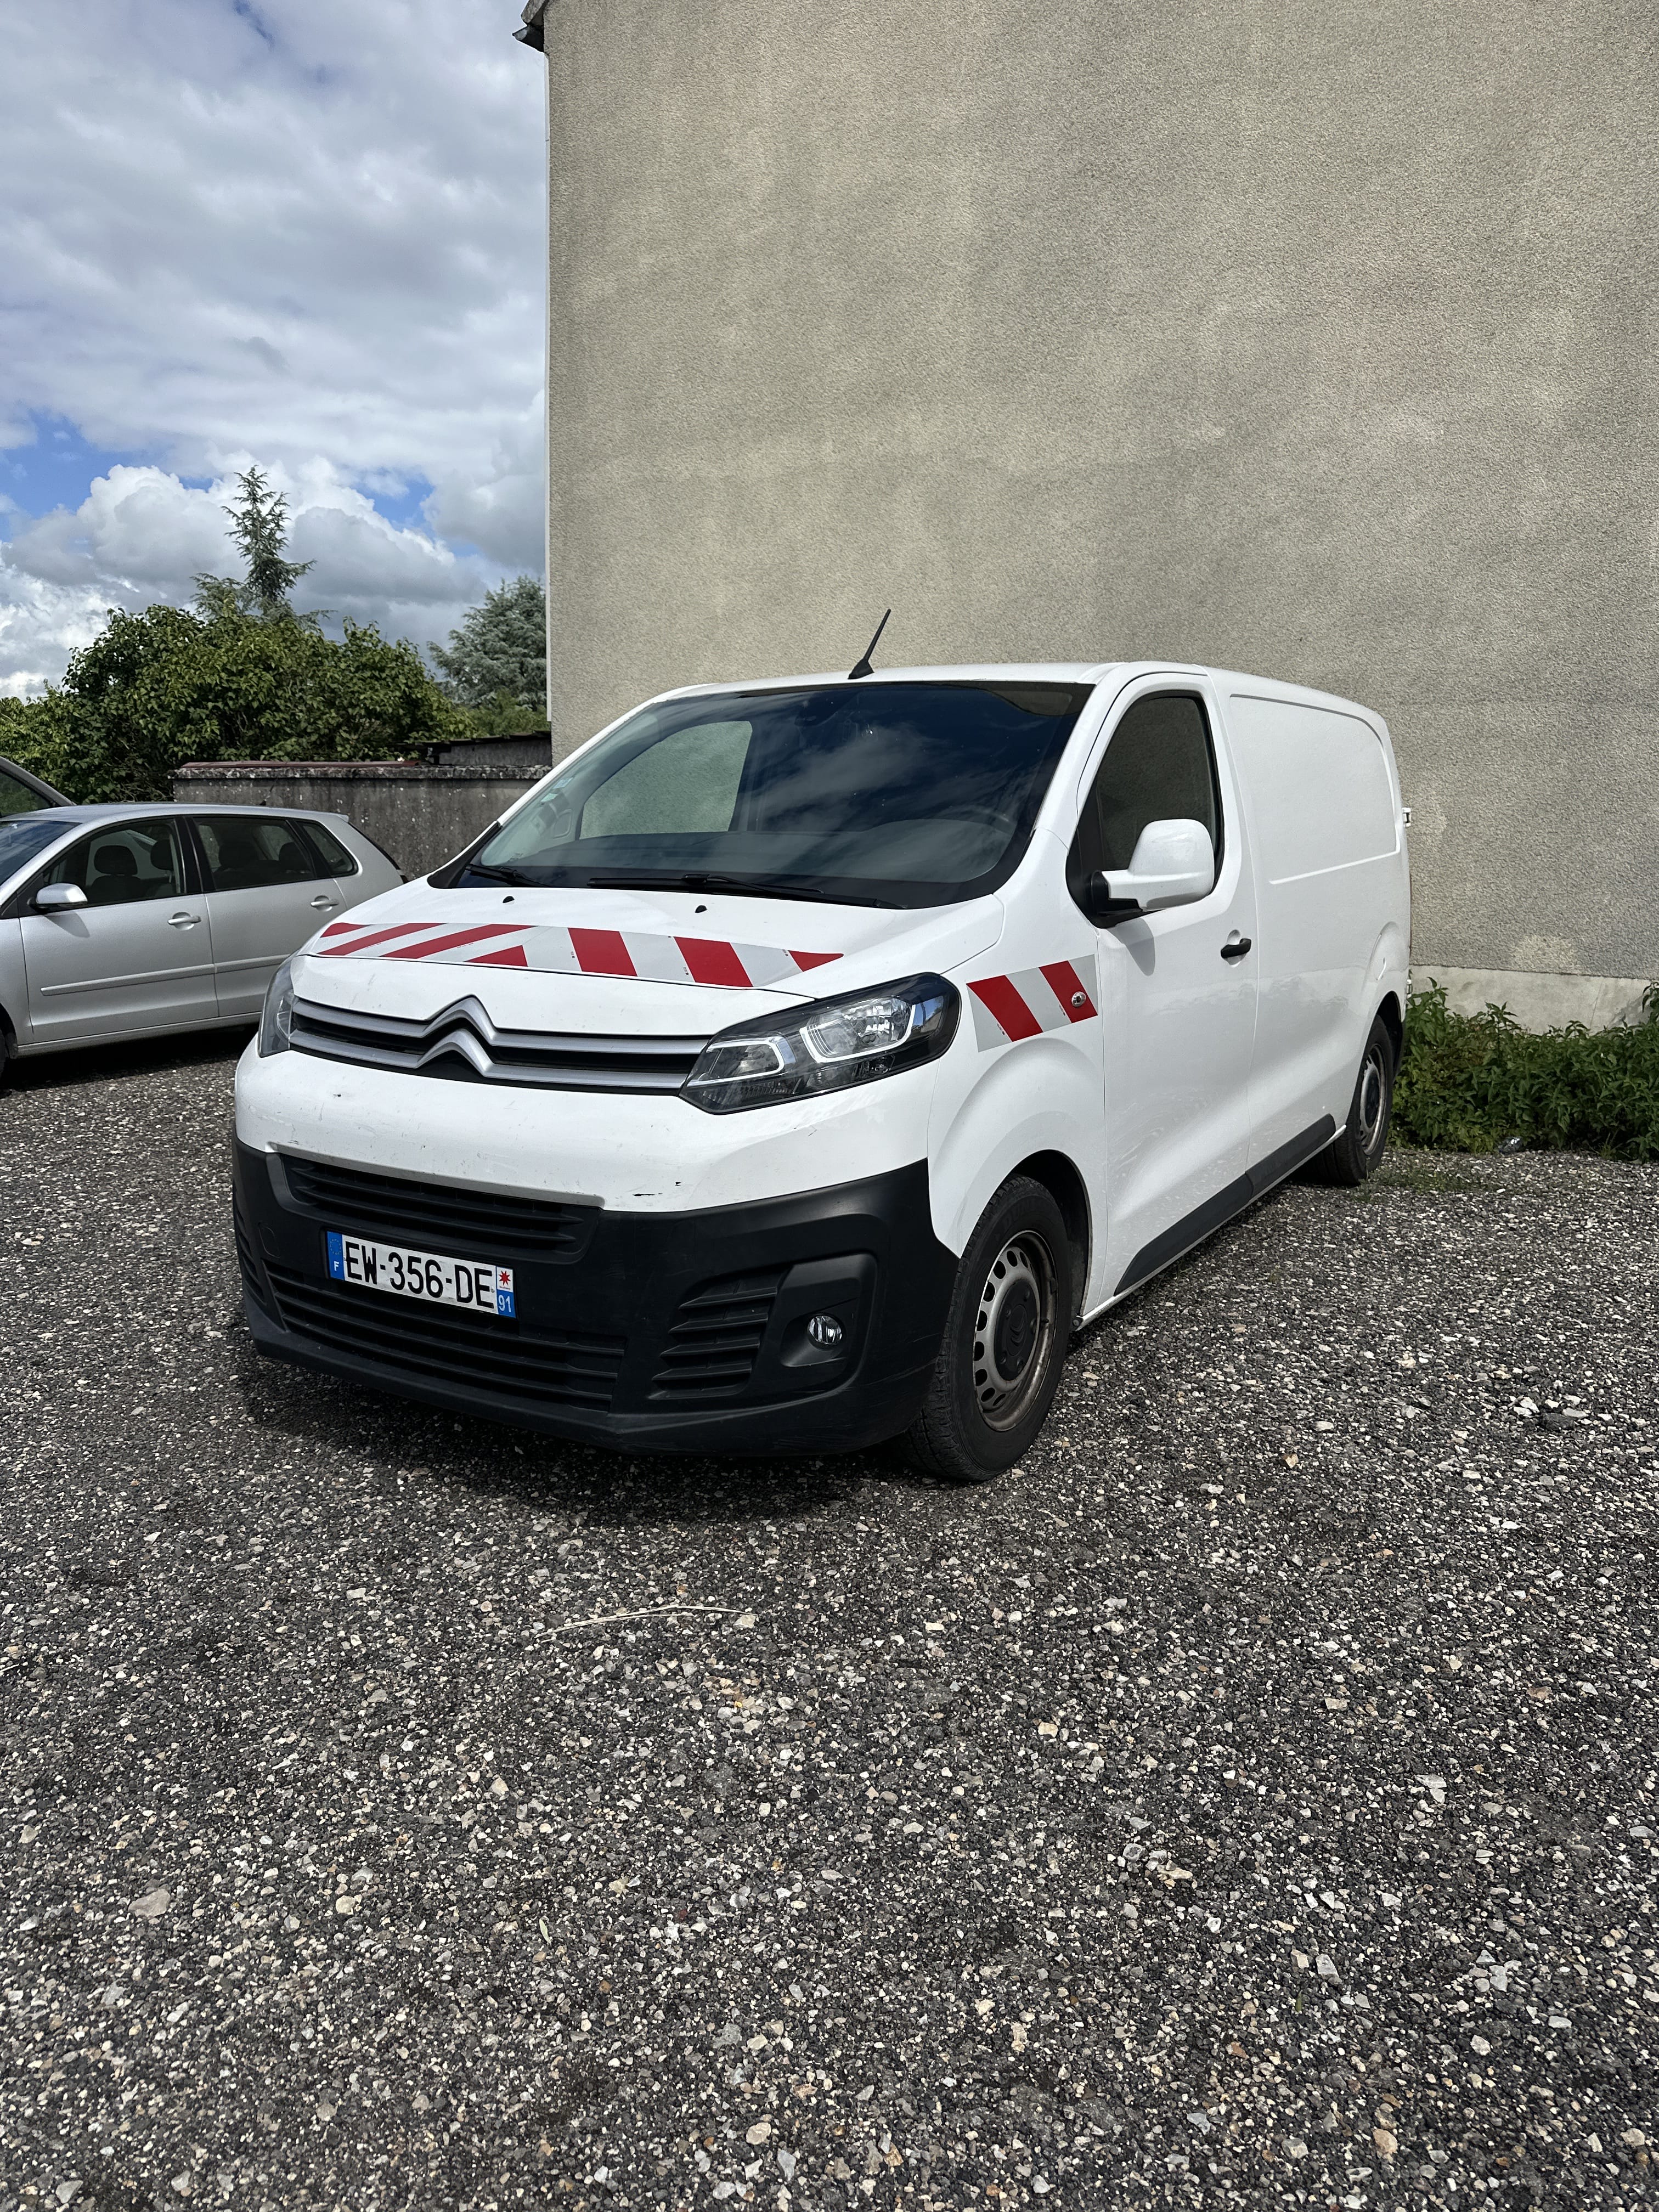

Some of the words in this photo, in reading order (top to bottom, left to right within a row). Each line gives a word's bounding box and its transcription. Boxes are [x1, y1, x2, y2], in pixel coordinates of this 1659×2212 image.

[334, 1261, 339, 1271] F
[345, 1241, 494, 1309] EW-356-DE
[498, 1294, 511, 1312] 91
